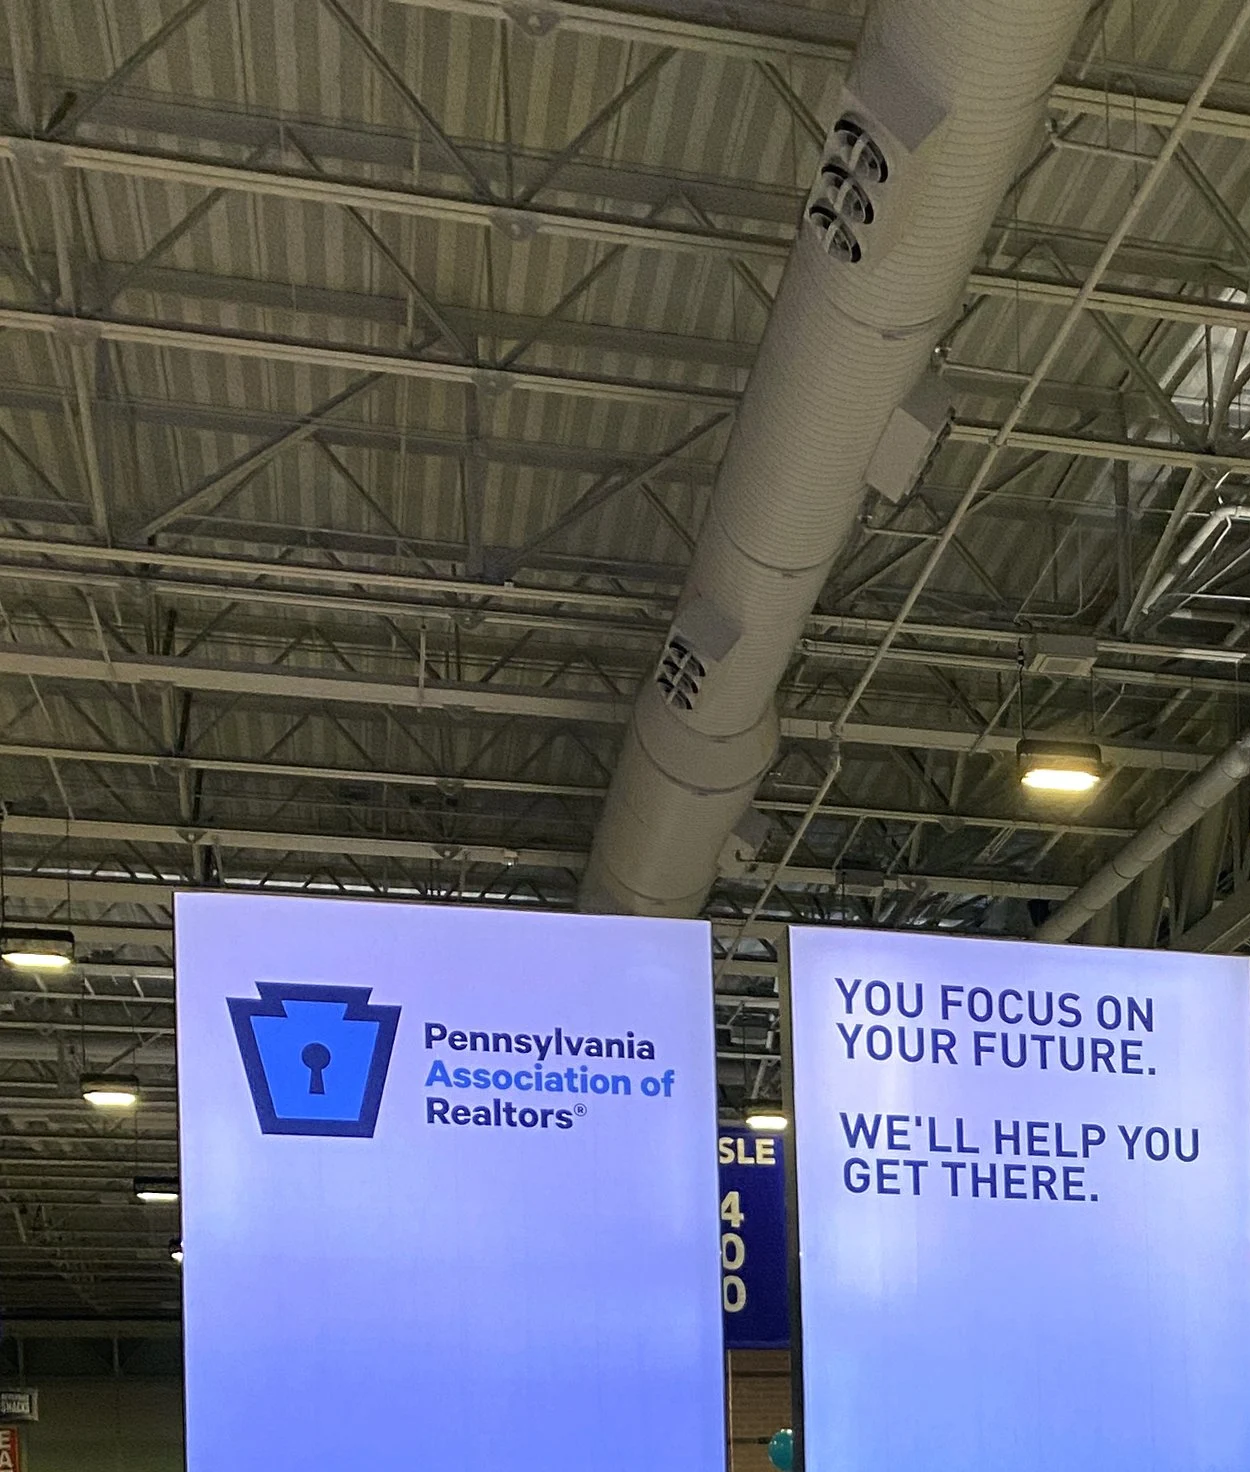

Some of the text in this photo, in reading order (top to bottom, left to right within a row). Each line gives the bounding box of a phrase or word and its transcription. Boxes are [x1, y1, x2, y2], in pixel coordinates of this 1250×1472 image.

[834, 977, 1154, 1033] YOU FOCUS ON
[424, 1022, 656, 1061] Pennsylvania
[836, 1022, 1156, 1076] YOUR FUTURE.
[425, 1059, 675, 1098] Association of
[839, 1111, 1200, 1163] WE'LL HELP YOU
[843, 1157, 1098, 1202] GET THERE.
